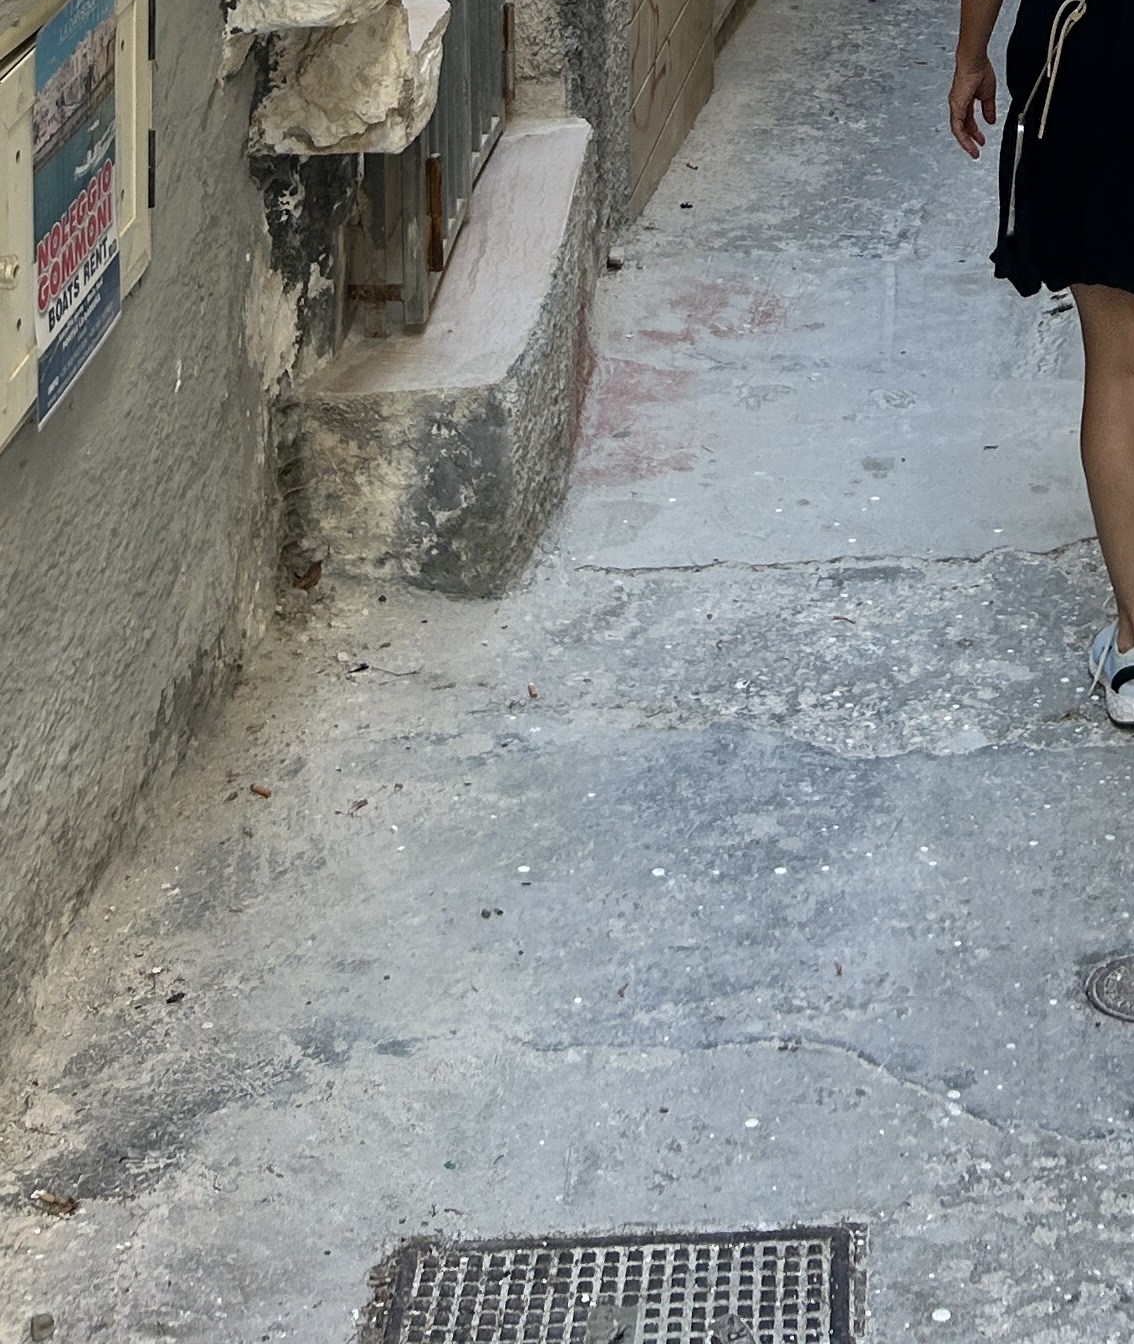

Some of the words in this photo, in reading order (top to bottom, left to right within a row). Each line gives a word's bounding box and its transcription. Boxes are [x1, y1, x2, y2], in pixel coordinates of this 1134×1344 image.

[37, 158, 113, 275] NOLEGGIO
[38, 193, 113, 313] GOMMONI
[48, 278, 80, 333] BOATS
[84, 235, 109, 285] RENT
